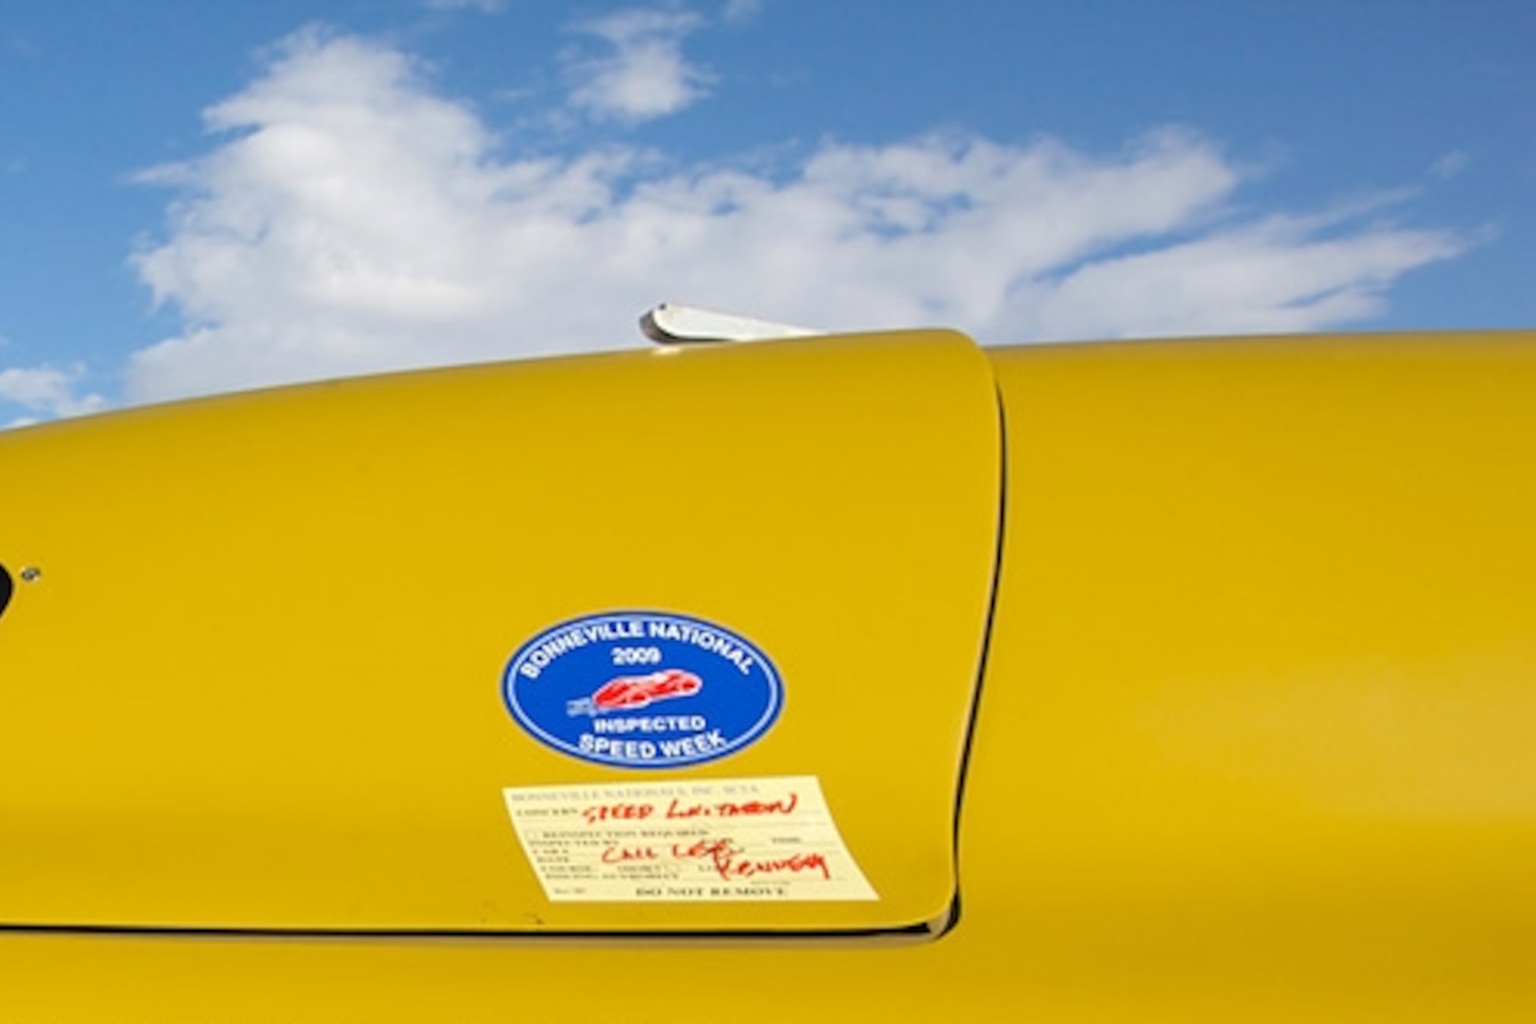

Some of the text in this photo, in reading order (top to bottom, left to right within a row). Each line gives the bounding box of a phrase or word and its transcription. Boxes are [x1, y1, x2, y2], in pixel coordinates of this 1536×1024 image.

[520, 621, 758, 680] BONNEVILLE NATIONAL
[611, 646, 663, 666] 2009
[593, 715, 707, 734] INSPECTED
[578, 727, 728, 760] SPEED WEEK
[582, 802, 654, 825] SPEED
